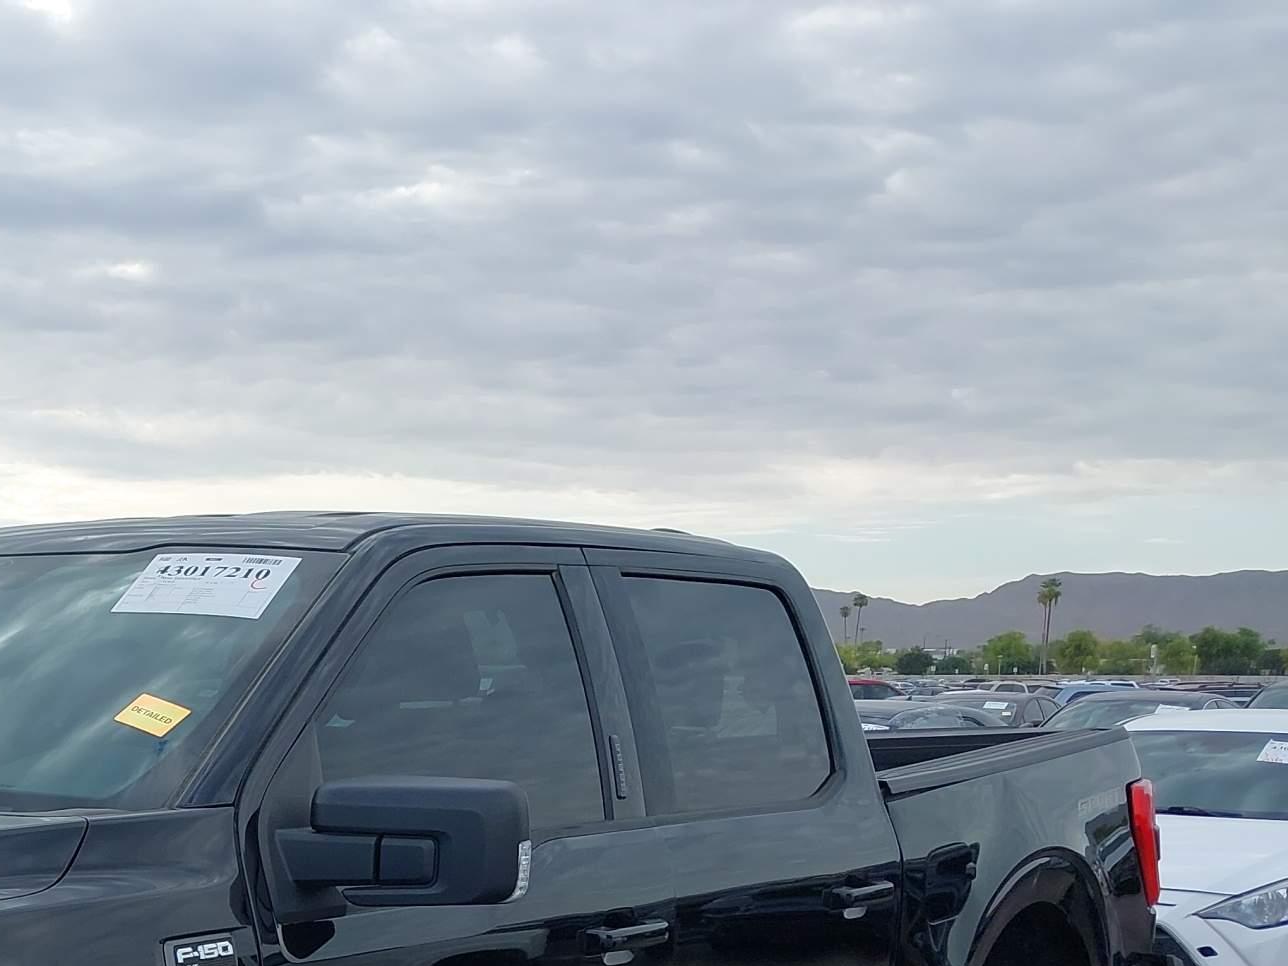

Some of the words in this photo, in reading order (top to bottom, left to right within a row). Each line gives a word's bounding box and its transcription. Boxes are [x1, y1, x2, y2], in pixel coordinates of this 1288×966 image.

[156, 564, 271, 581] 43017210
[131, 705, 173, 725] DETAILED
[176, 940, 234, 962] F-150
